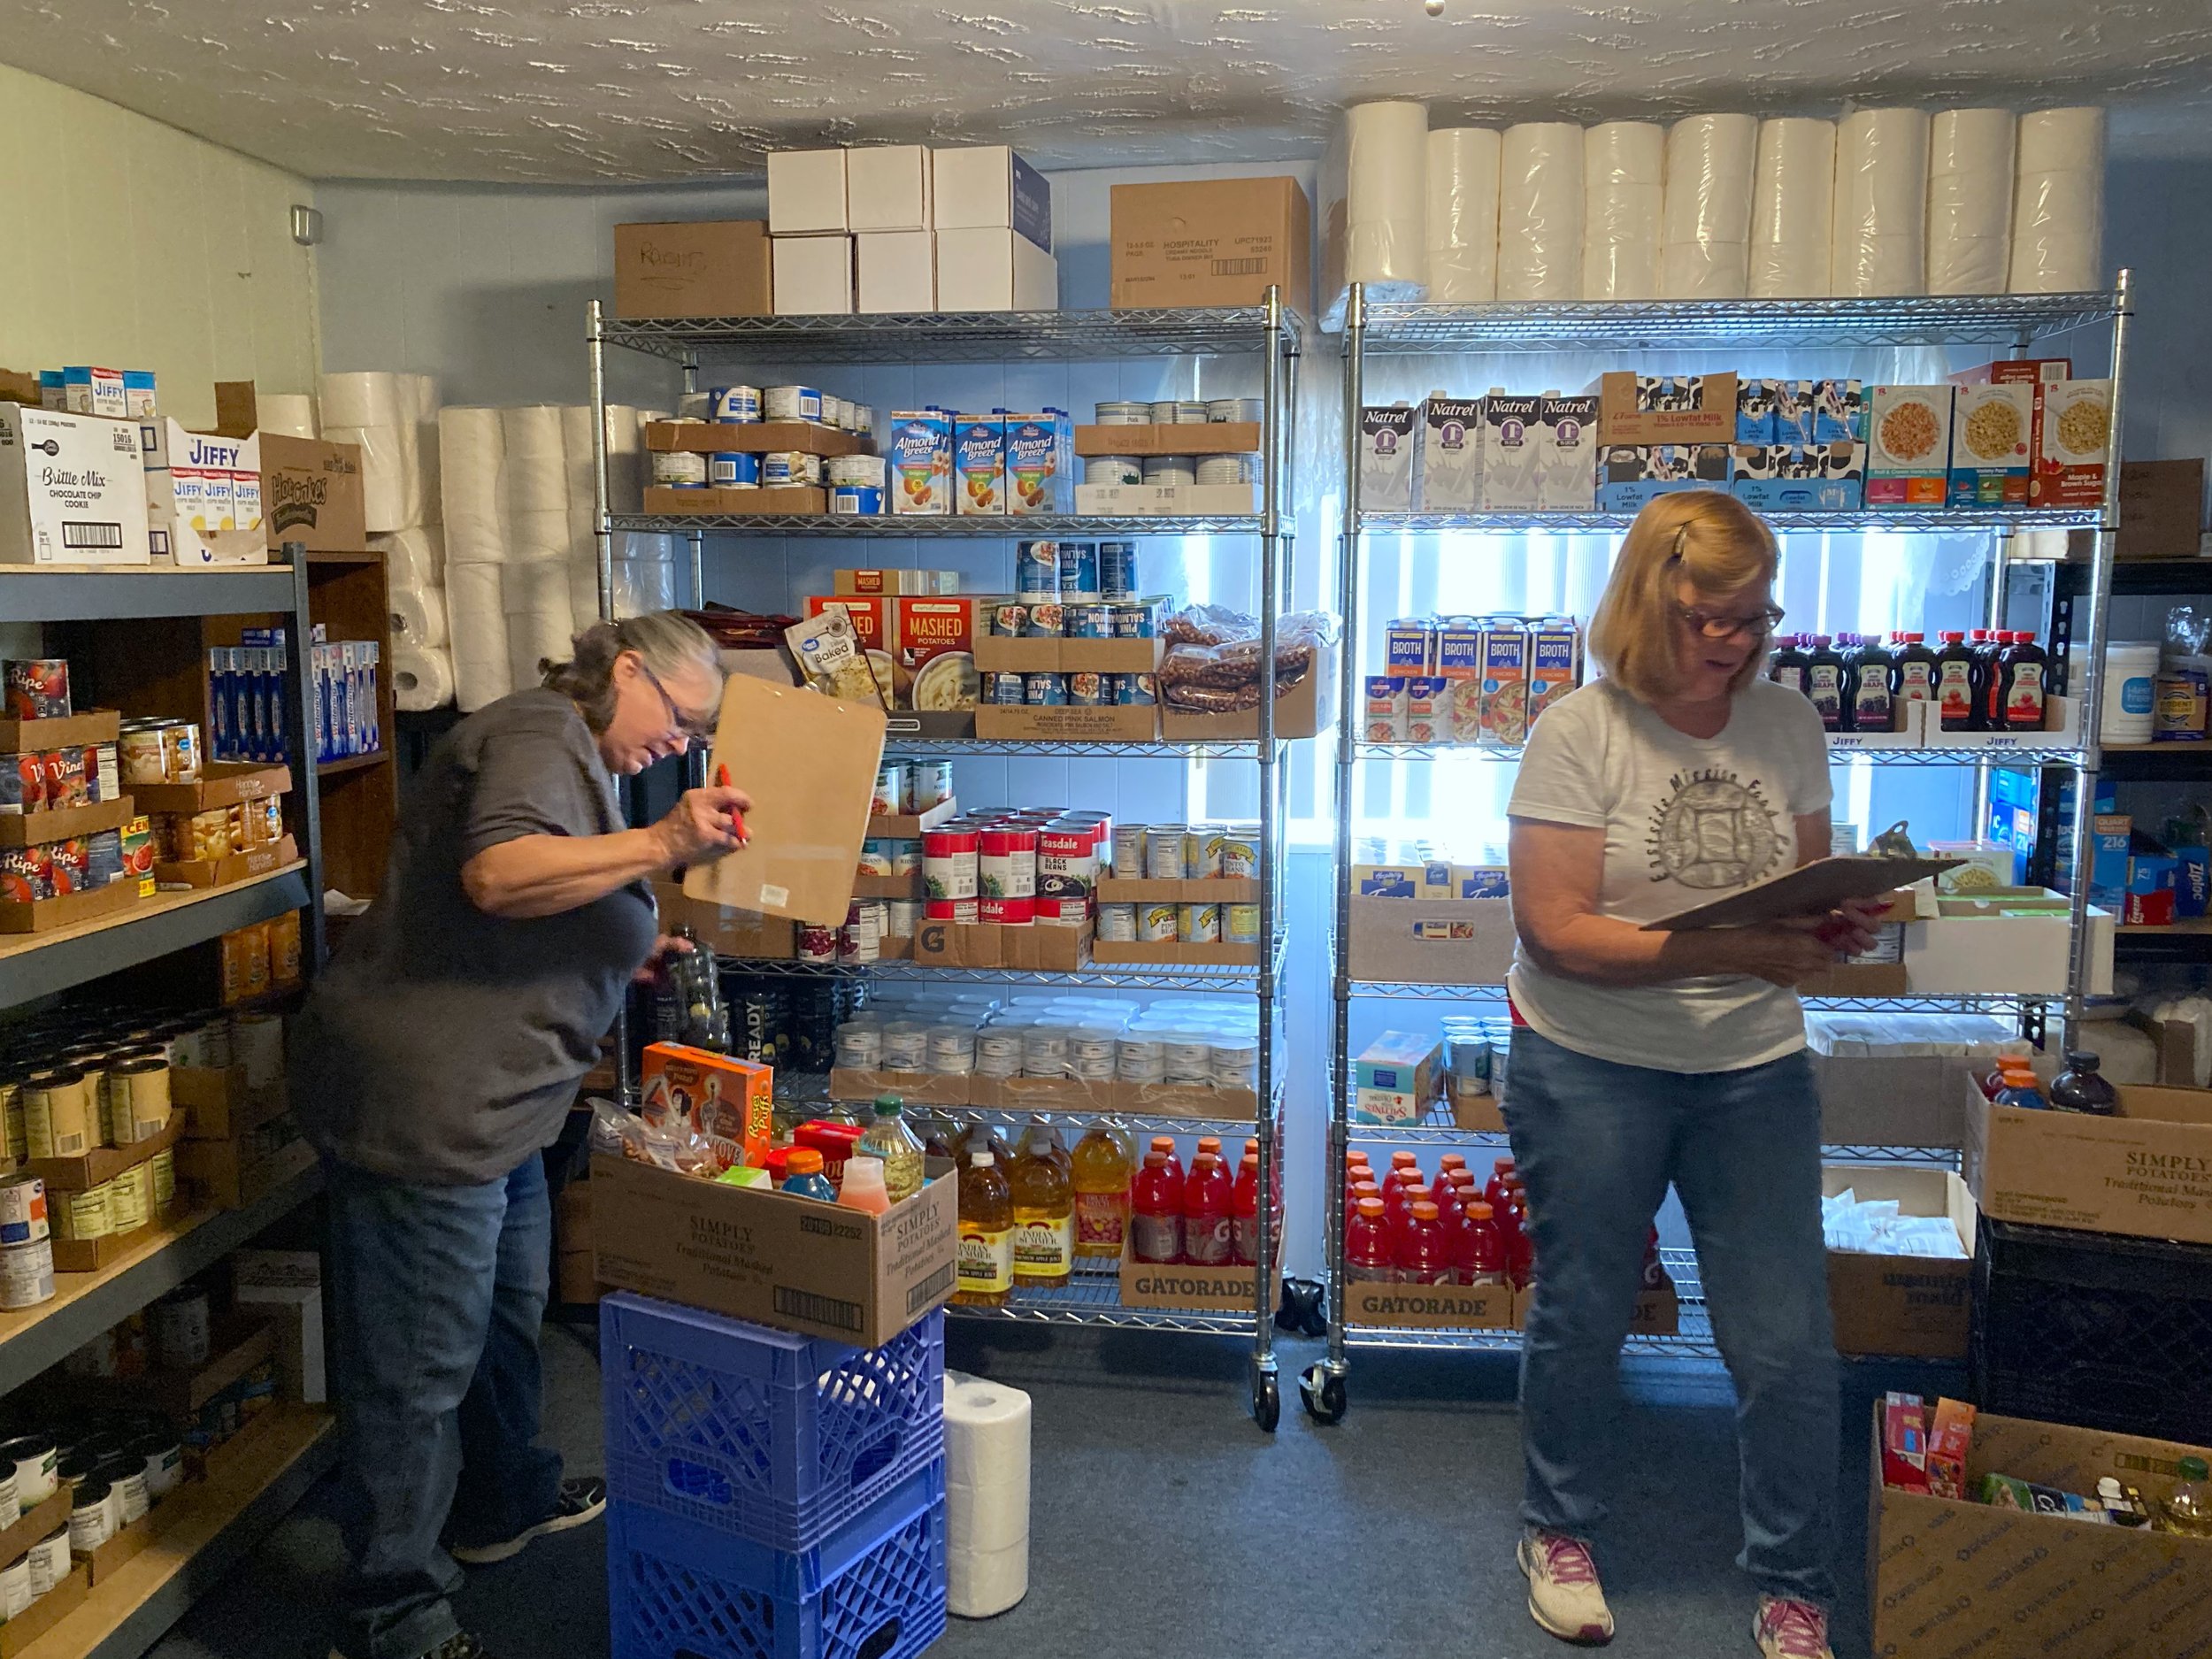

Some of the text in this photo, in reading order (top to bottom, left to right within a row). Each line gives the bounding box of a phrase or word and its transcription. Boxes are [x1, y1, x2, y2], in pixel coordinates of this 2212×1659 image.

[1164, 239, 1219, 249] HOSPITALITY
[95, 381, 125, 398] JIFFY
[1431, 403, 1477, 416] Natrel
[1490, 399, 1536, 413] Natrel
[1544, 398, 1592, 413] Natrel
[1364, 411, 1409, 424] Natrel
[1671, 413, 1701, 422] Lowfat
[895, 434, 940, 450] Almond
[959, 436, 1002, 454] Almond
[1010, 436, 1053, 453] Almond
[903, 446, 933, 458] Breeze
[967, 449, 995, 461] Breeze
[1018, 448, 1046, 460] Breeze
[42, 466, 106, 488] Brittle Mix
[50, 489, 101, 500] CHOCOLATE CHIP
[174, 481, 202, 496] JIFFY
[205, 483, 232, 497] JIFFY
[235, 485, 259, 499] JIFFY
[65, 500, 89, 509] COOKIE
[910, 618, 963, 637] MASHED
[918, 637, 956, 646] POTATOES
[1393, 641, 1422, 655] BROTH
[815, 644, 849, 664] Baked
[1444, 643, 1474, 657] BROTH
[1491, 643, 1520, 657] BROTH
[1540, 644, 1570, 657] BROTH
[12, 668, 44, 690] Ripe
[1986, 737, 2018, 746] JIFFY
[1670, 768, 1738, 793] Mission
[1041, 834, 1078, 850] Teasdale
[2103, 836, 2127, 849] 216
[5, 853, 41, 874] Ripe
[2127, 1152, 2211, 1171] SIMPLY
[2127, 1167, 2211, 1183] POTATOES
[897, 1202, 940, 1239] SIMPLY
[690, 1216, 755, 1242] SIMPLY
[897, 1217, 941, 1253] POTATOES
[1136, 1278, 1255, 1298] GATORADE
[1363, 1296, 1487, 1316] GATORADE
